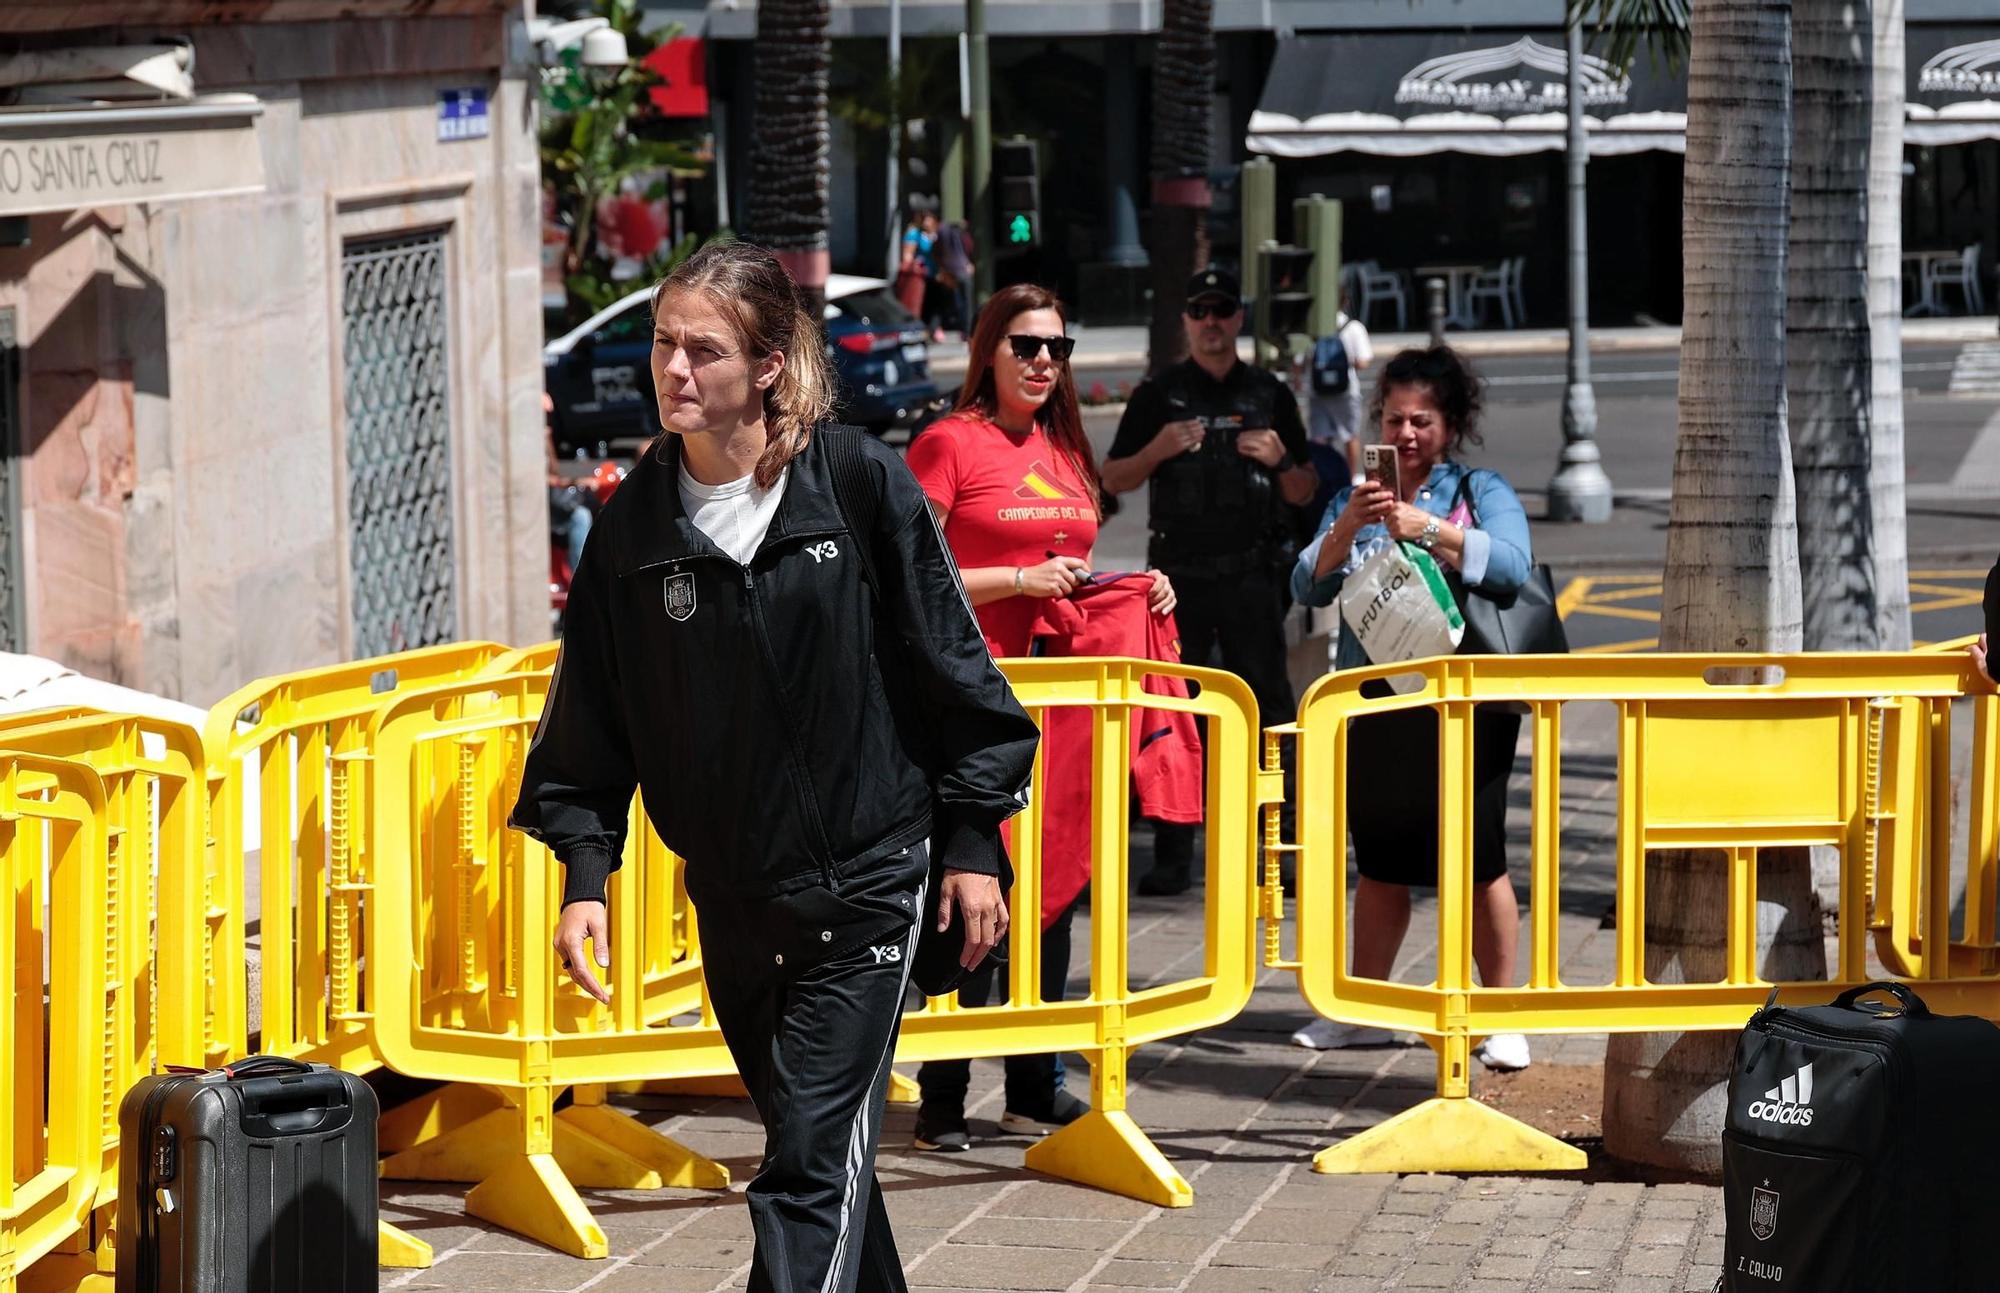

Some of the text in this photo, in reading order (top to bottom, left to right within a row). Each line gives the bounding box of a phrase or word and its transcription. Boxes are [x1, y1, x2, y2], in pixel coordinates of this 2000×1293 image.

[28, 145, 102, 191] SANTA
[106, 140, 163, 186] CRUZ
[998, 507, 1060, 521] CAMPEONAS
[1061, 507, 1079, 520] DEL
[1361, 567, 1411, 631] FUTBOL
[1748, 1100, 1813, 1126] adidas
[1737, 1256, 1782, 1281] I. CALVO
